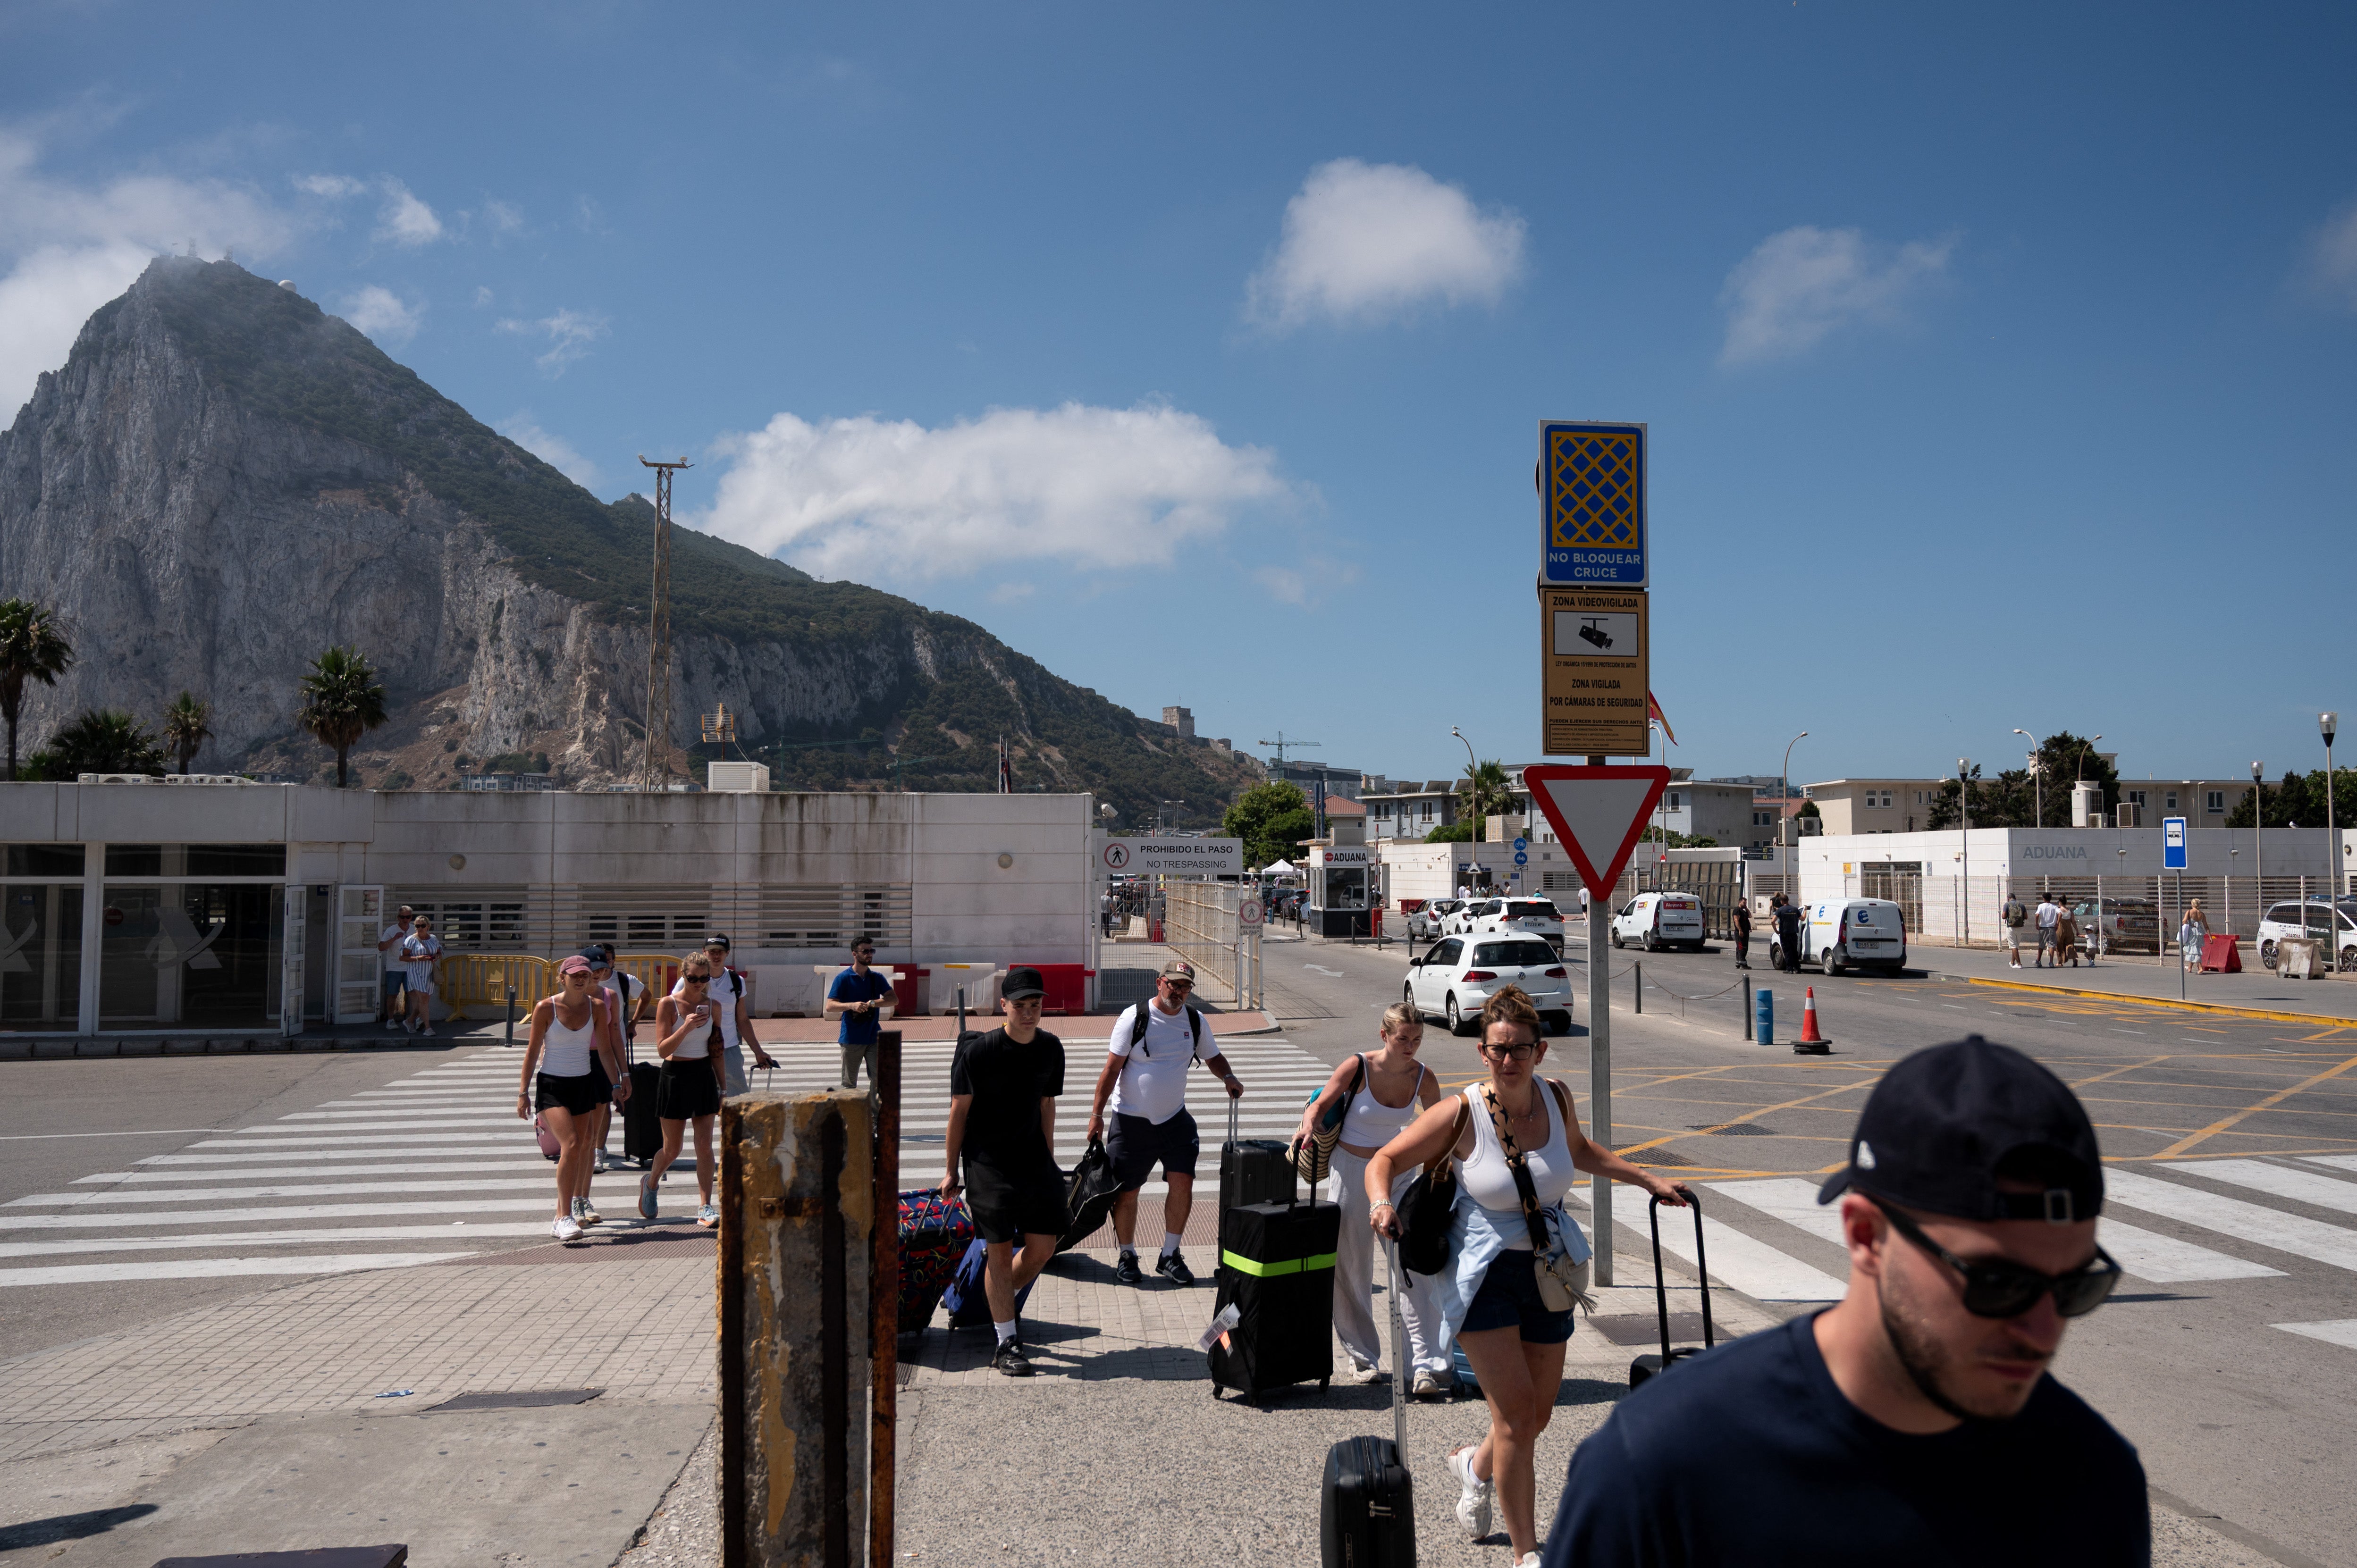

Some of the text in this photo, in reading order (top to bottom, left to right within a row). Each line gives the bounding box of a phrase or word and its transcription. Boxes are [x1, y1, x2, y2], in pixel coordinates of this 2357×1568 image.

[1549, 553, 1641, 564] NO BLOQUEAR
[1574, 567, 1617, 578] CRUCE
[1553, 596, 1638, 608] ZONA VIDEOVIGILADA
[1563, 659, 1580, 667] ORGÁNICA
[1572, 679, 1621, 689] ZONA VIGILADA
[1550, 695, 1643, 707] POR CÁMARAS DE SEGURIDAD
[1334, 853, 1366, 862] ADUANA
[2023, 847, 2087, 859] ADUANA
